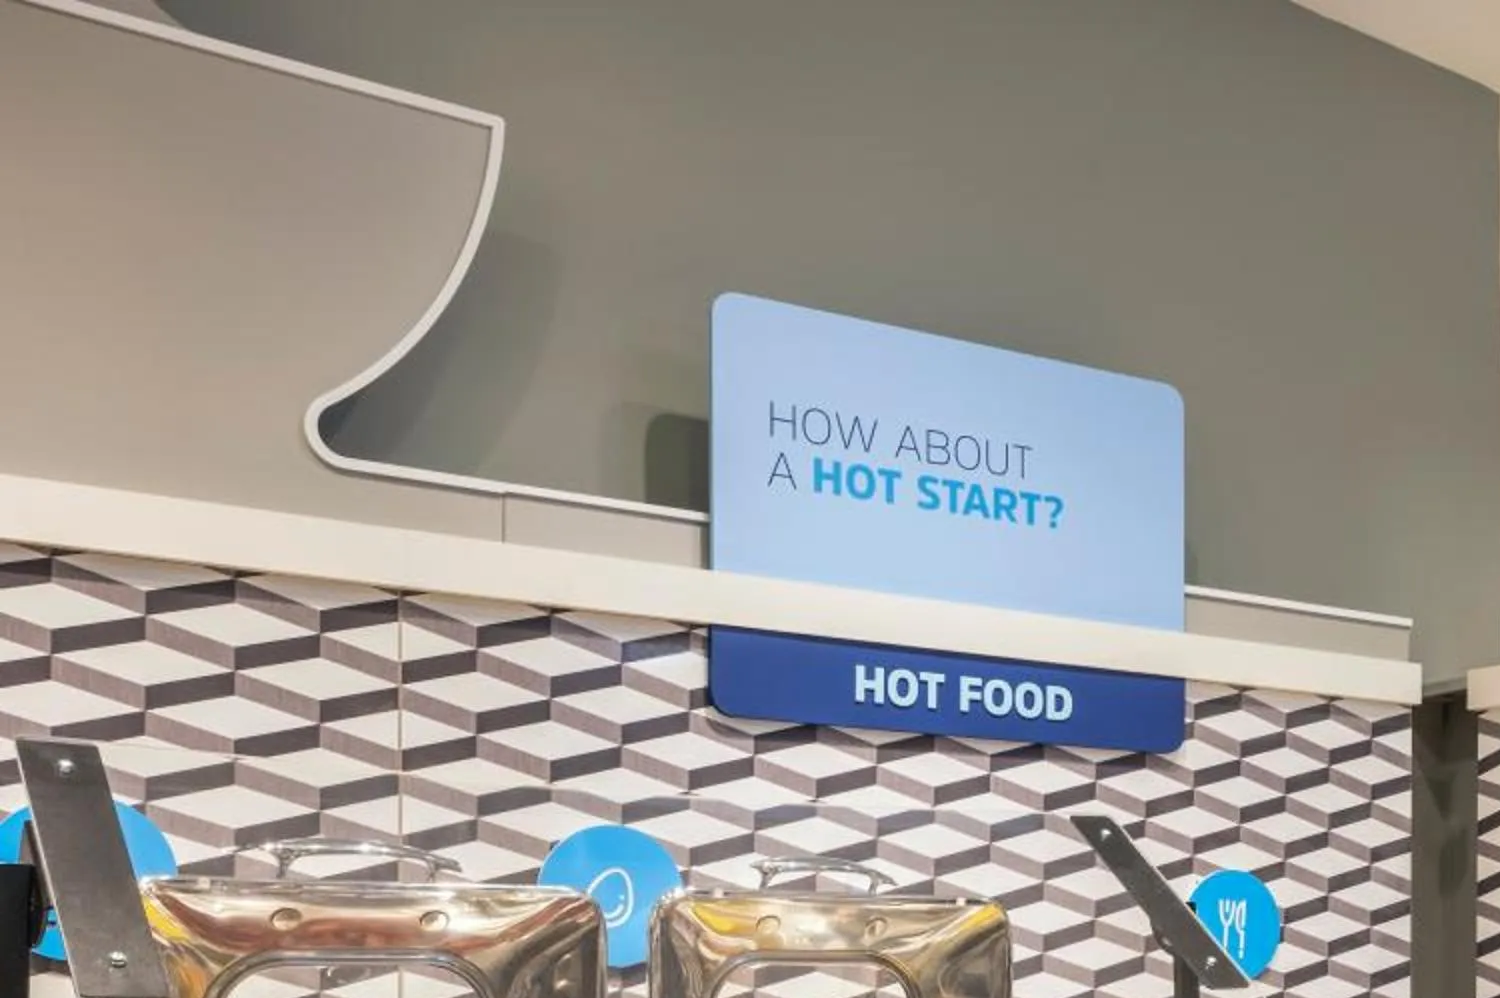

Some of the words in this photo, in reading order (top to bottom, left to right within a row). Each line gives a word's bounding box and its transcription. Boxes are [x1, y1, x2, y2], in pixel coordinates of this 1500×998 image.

[769, 401, 879, 453] HOW
[895, 425, 1032, 479] ABOUT
[768, 452, 797, 490] A
[812, 457, 902, 504] HOT
[917, 475, 1065, 529] START?
[855, 664, 945, 709] HOT
[959, 675, 1073, 721] FOOD
